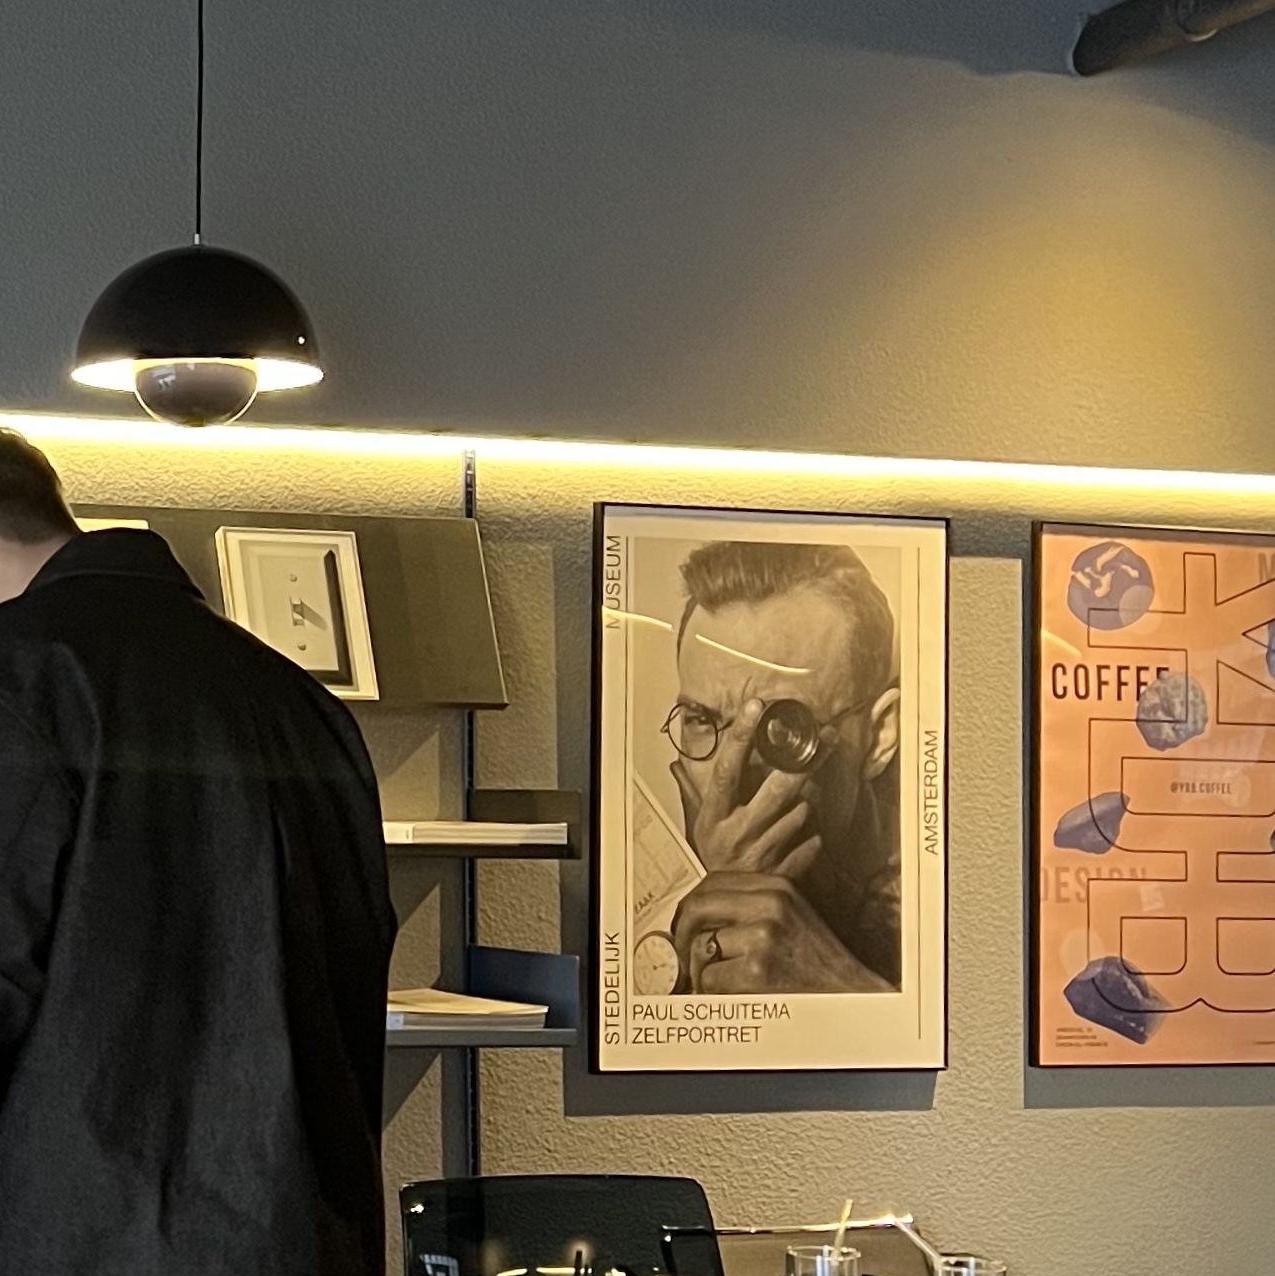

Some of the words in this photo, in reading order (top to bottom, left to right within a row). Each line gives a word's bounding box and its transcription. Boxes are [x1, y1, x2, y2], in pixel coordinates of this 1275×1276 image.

[606, 535, 621, 629] MUSEUM
[1051, 662, 1170, 702] COFFE
[923, 729, 939, 856] AMSTERDAM
[605, 932, 620, 1044] STEDELIJK
[632, 1003, 678, 1020] PAUL
[684, 1003, 790, 1020] SCHUITEMA
[632, 1026, 761, 1044] ZELFPORTRET
